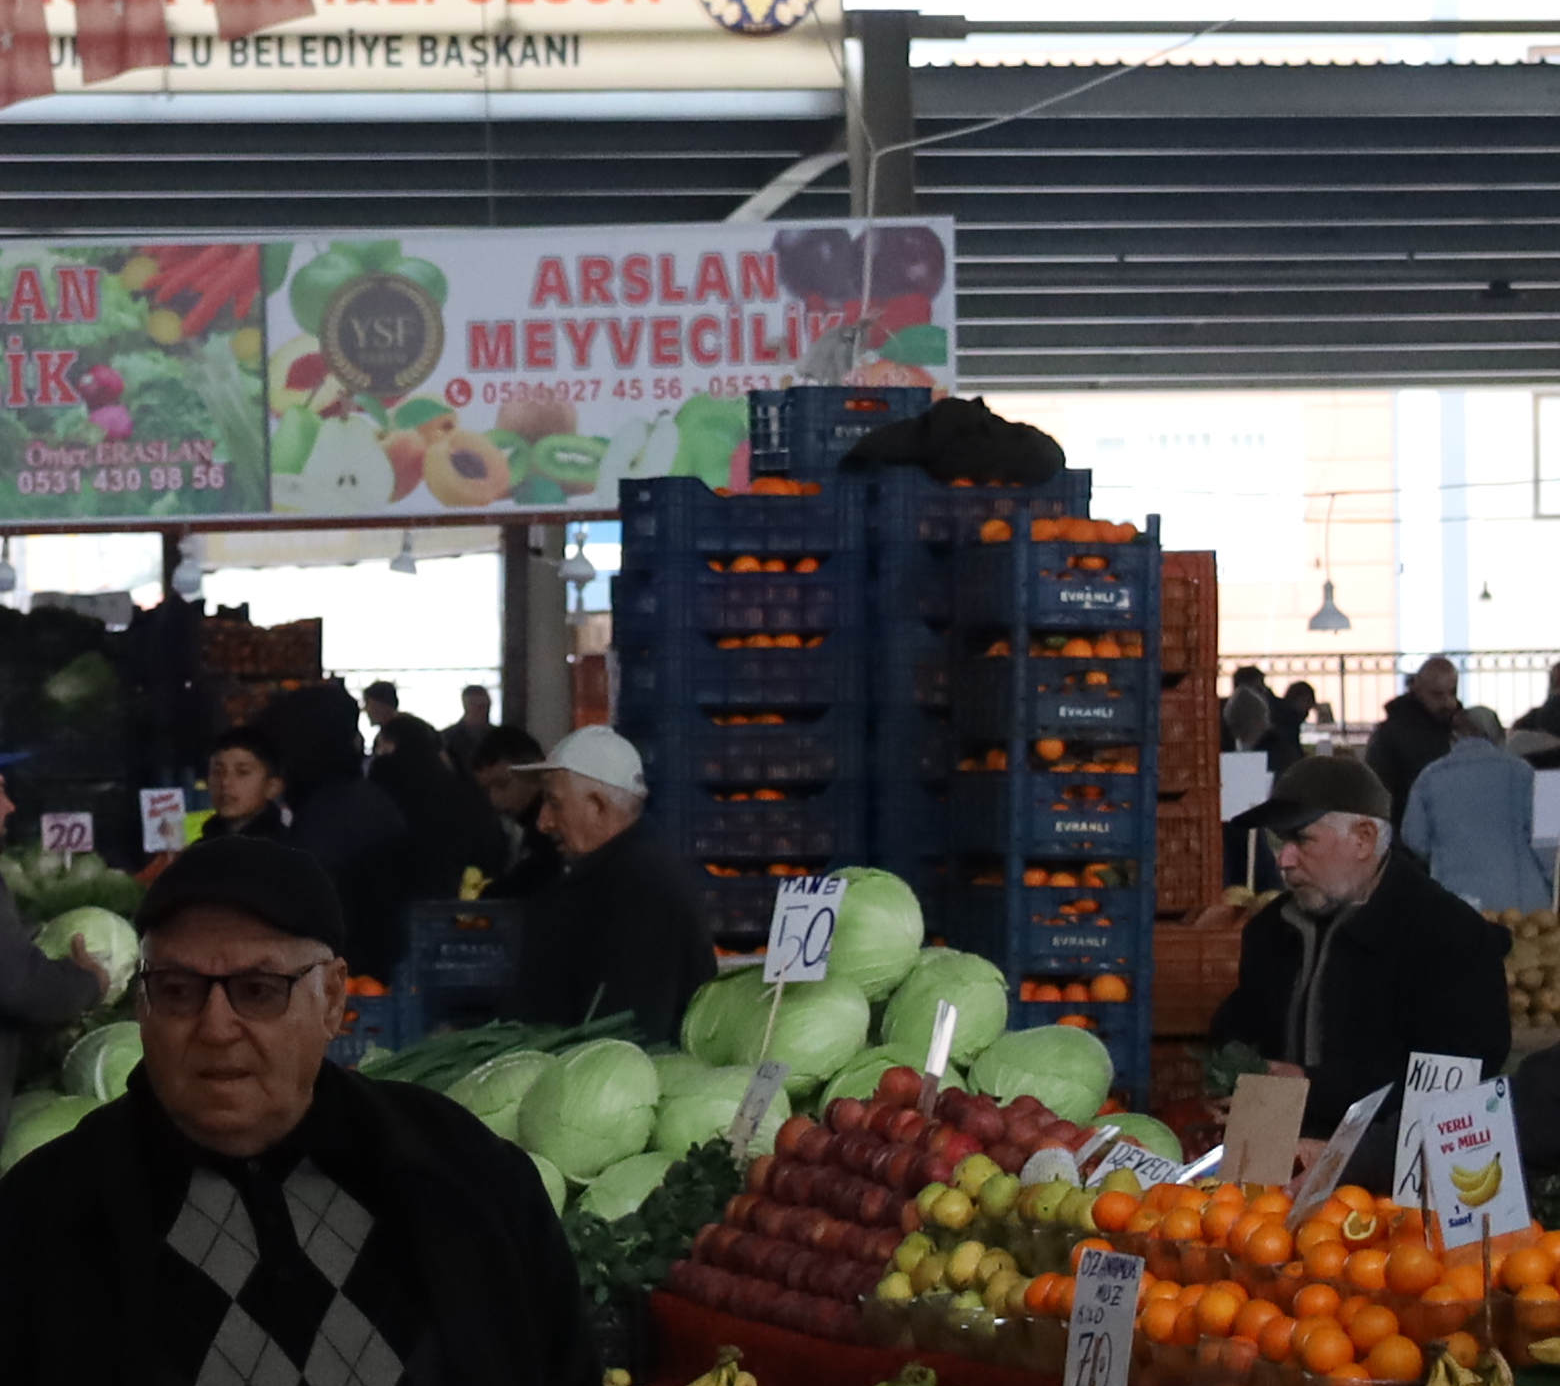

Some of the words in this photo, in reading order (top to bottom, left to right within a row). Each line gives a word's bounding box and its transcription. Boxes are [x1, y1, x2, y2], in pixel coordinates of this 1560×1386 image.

[229, 29, 404, 69] BELEDİYE
[418, 33, 581, 77] BAŞKANI
[528, 249, 777, 309] ARSLAN
[611, 376, 645, 401] 45
[652, 374, 682, 399] 56
[17, 469, 82, 495] 0531
[92, 467, 142, 492] 430
[149, 465, 184, 490] 98
[192, 463, 225, 489] 56
[49, 822, 86, 850] 20
[774, 904, 835, 977] 50
